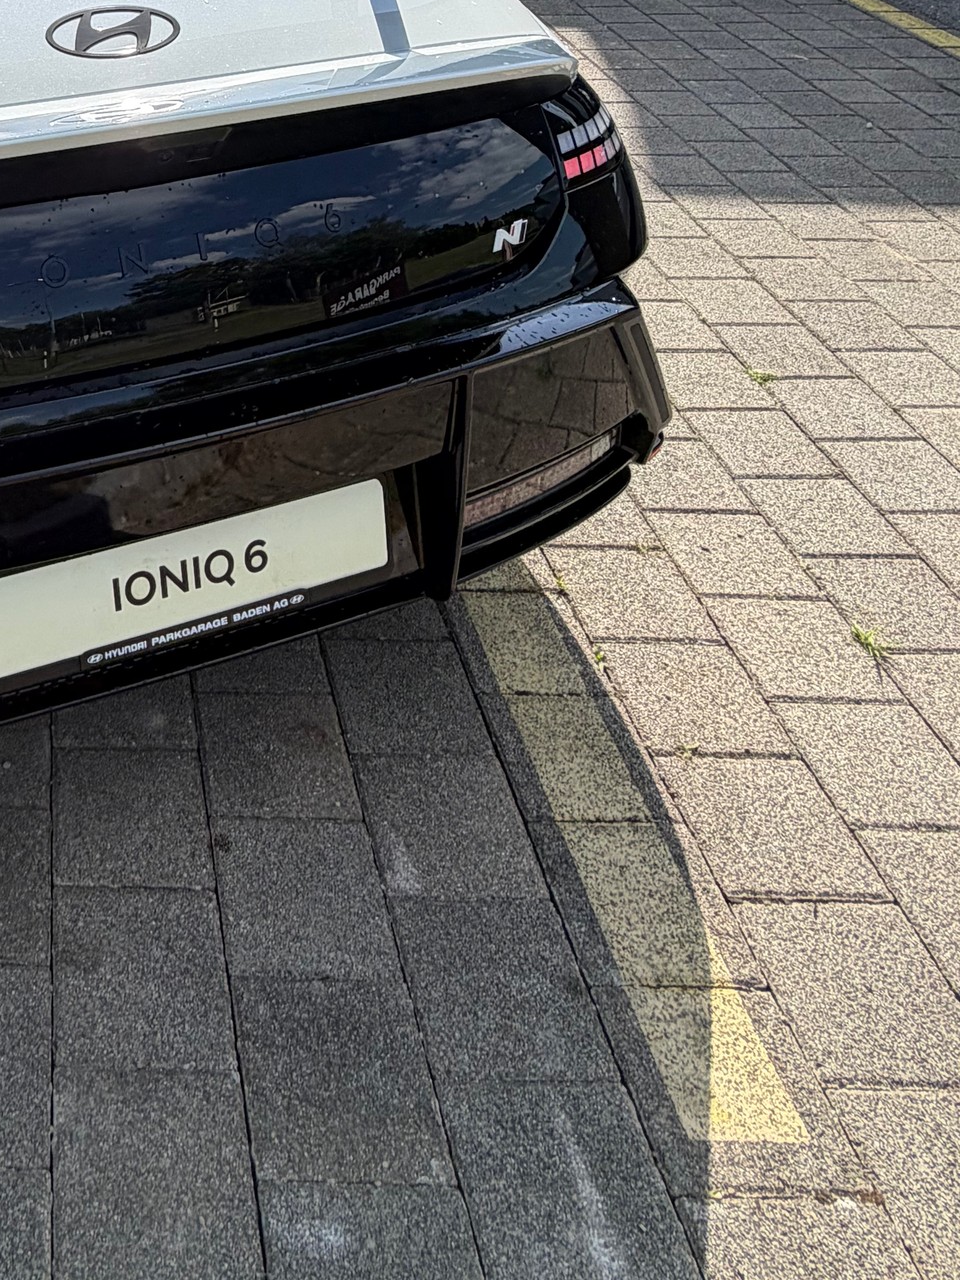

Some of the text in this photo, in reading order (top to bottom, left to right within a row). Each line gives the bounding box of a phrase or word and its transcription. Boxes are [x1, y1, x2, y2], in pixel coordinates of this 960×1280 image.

[323, 203, 342, 234] 6
[492, 218, 528, 253] N
[112, 539, 268, 612] IONIQ 6
[104, 598, 289, 660] HYUNDAI PARKGARAGE BADEN AG
